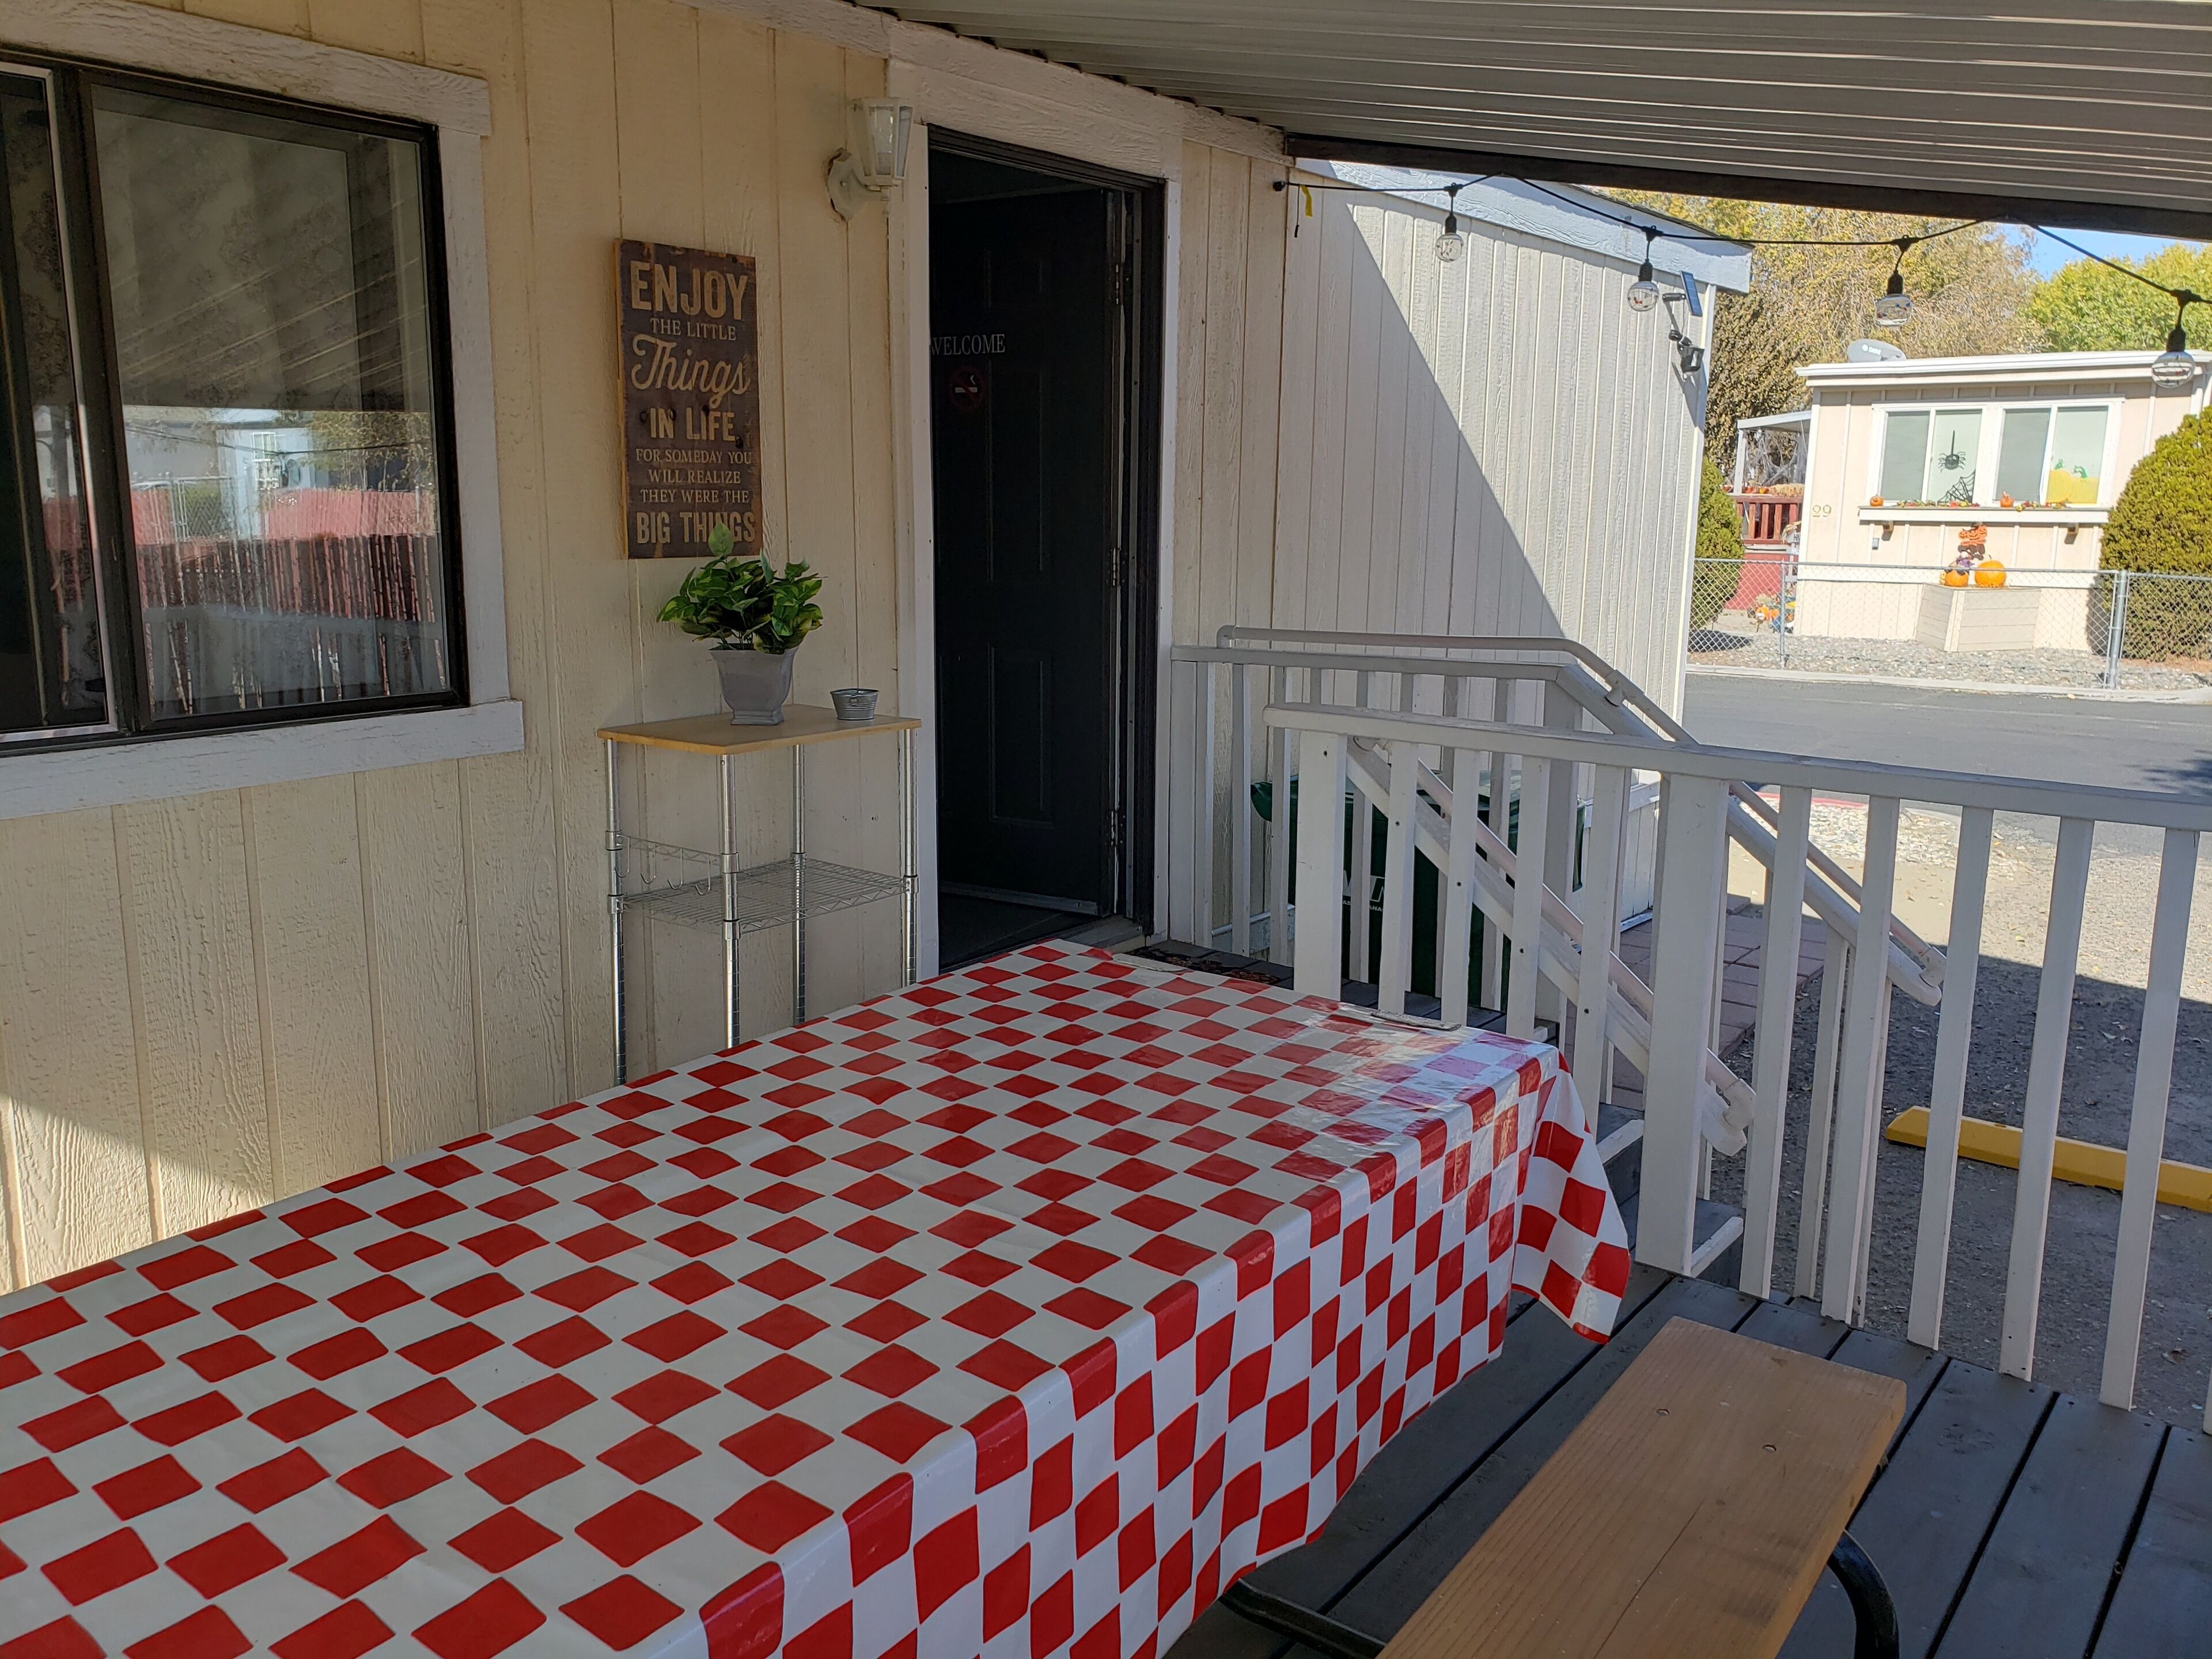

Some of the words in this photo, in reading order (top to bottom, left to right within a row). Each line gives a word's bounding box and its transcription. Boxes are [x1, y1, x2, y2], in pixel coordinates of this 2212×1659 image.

[630, 260, 748, 320] ENJOY
[650, 317, 681, 336] THE
[687, 321, 737, 341] LITTLE
[930, 334, 1005, 355] WELCOME
[631, 334, 751, 408] Things
[650, 408, 674, 438] IN
[686, 407, 736, 441] LIFE
[636, 448, 660, 461] FOR
[665, 449, 722, 463] SOMEDAY
[728, 451, 752, 464] YOU
[649, 469, 682, 483] WILL
[687, 470, 741, 484] REALIZE
[640, 489, 676, 503] THEY
[681, 490, 719, 503] WERE
[723, 490, 749, 503] THE
[1813, 505, 1831, 517] 29
[637, 512, 670, 544] BIG
